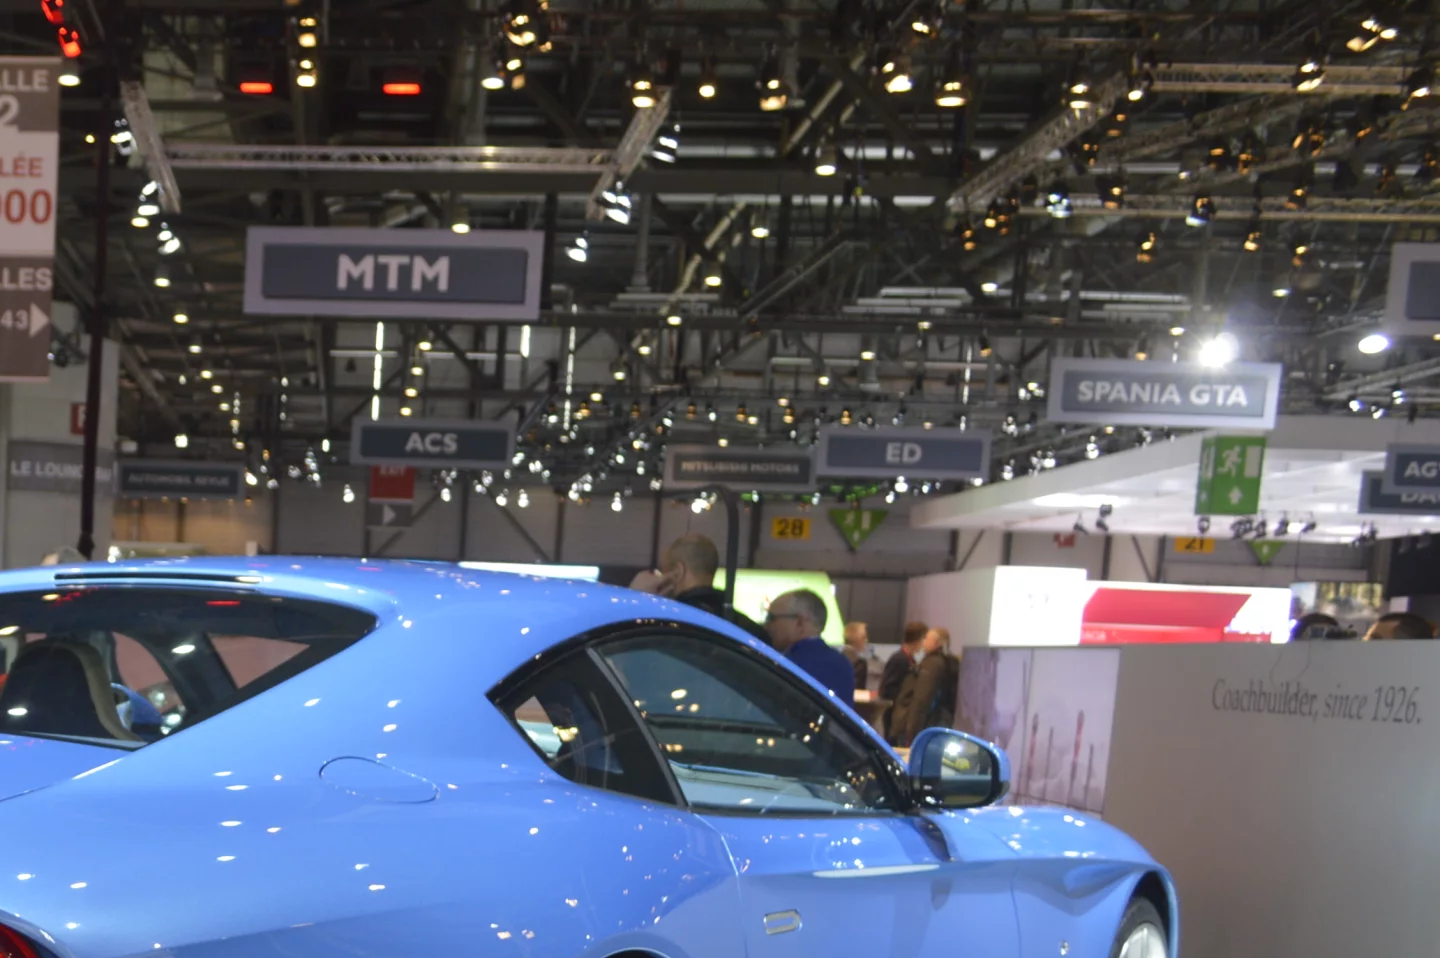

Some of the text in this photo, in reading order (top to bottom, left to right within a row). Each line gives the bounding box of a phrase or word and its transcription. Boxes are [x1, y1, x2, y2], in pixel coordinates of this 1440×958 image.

[336, 253, 450, 293] MTM
[1078, 380, 1249, 407] SPANIA GTA
[405, 431, 459, 454] ACS
[885, 441, 923, 465] ED
[1404, 460, 1440, 478] AG
[776, 518, 805, 538] 28
[1212, 678, 1423, 724] Coachbuilder, since 1926.
